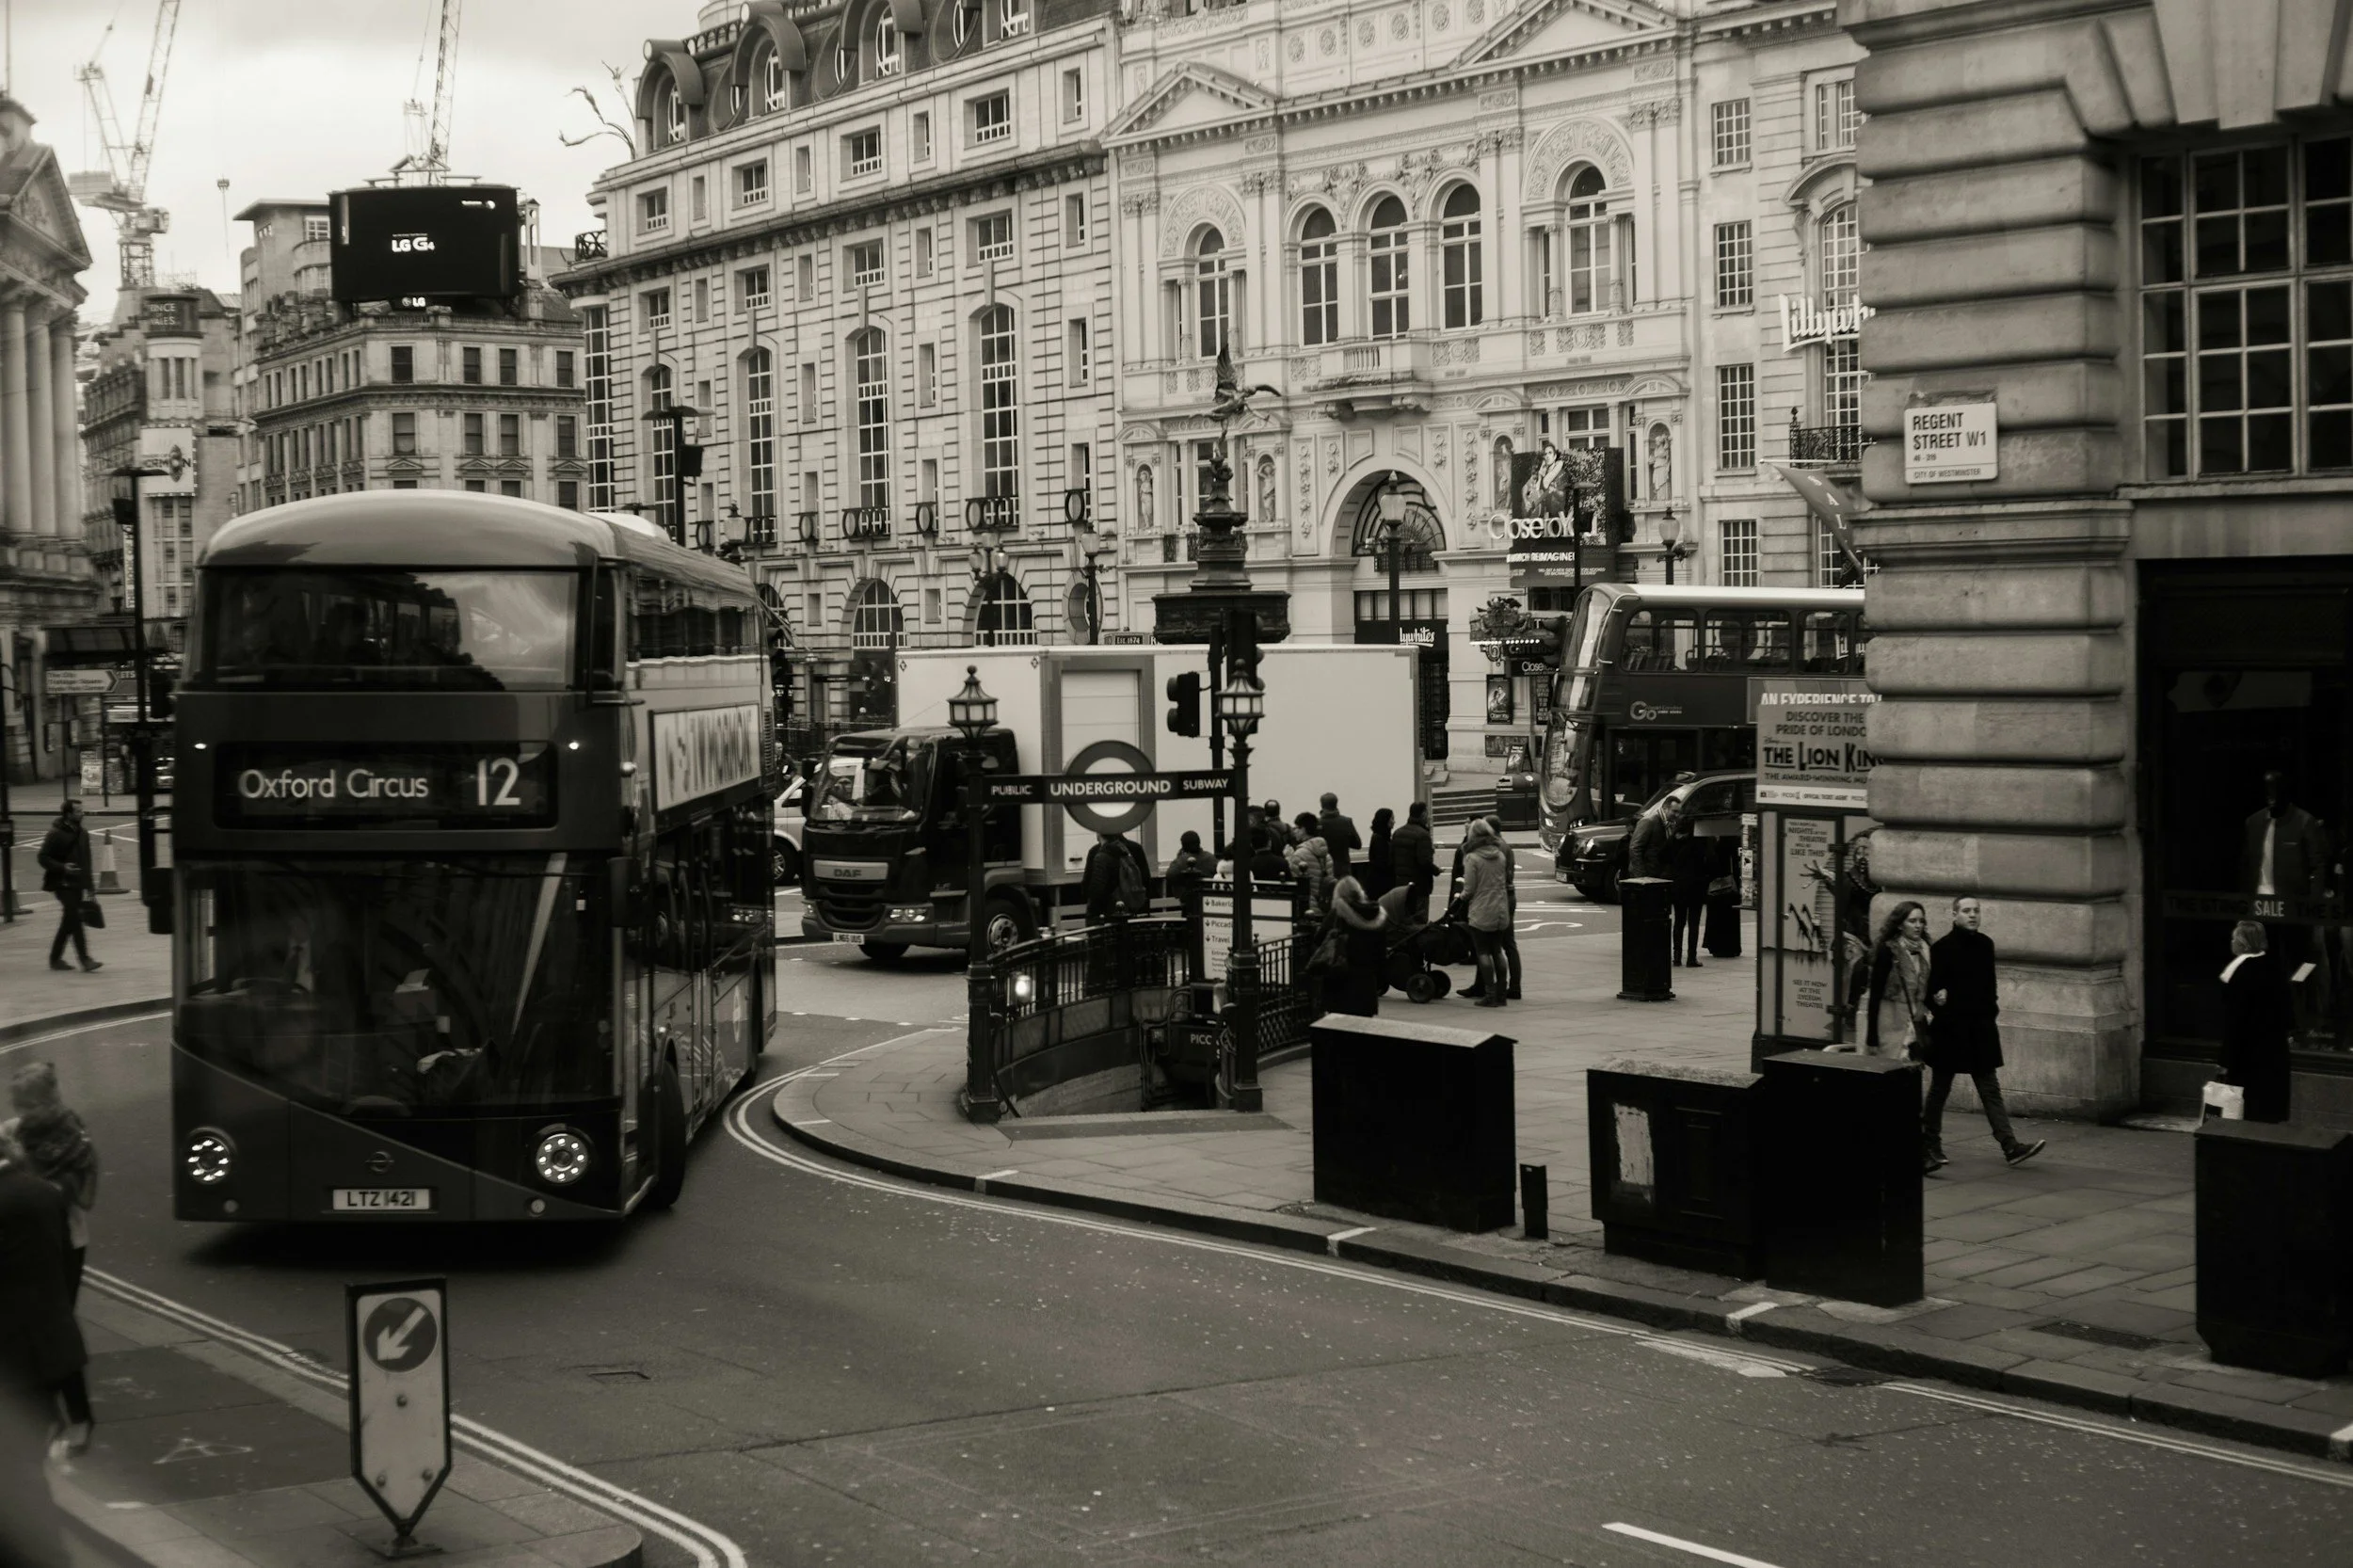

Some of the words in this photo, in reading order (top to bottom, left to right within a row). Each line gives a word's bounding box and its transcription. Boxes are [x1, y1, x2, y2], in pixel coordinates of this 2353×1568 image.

[392, 239, 411, 252] LG
[412, 236, 435, 251] G4
[413, 296, 426, 307] LG
[1780, 294, 1876, 353] Lillywh
[1913, 412, 1964, 431] REGENT
[1913, 432, 1962, 450] STREET
[1965, 430, 1987, 447] W1
[1914, 471, 1928, 479] CITY
[1938, 468, 1981, 477] WESTMINSTER
[1785, 711, 1841, 723] DISCOVER
[1844, 712, 1865, 724] THE
[1776, 724, 1806, 735] PRIDE
[1809, 725, 1824, 735] OF
[1763, 746, 1794, 764] THE
[1799, 742, 1840, 771] LION
[238, 769, 335, 798] Oxford
[347, 768, 429, 797] Circus
[477, 757, 521, 807] 12
[1765, 773, 1781, 781] THE
[991, 785, 1033, 796] PUBLIC
[1049, 780, 1171, 796] UNDERGROUND
[1182, 778, 1229, 791] SUBWAY
[834, 869, 861, 877] DAF
[2253, 900, 2285, 918] SALE
